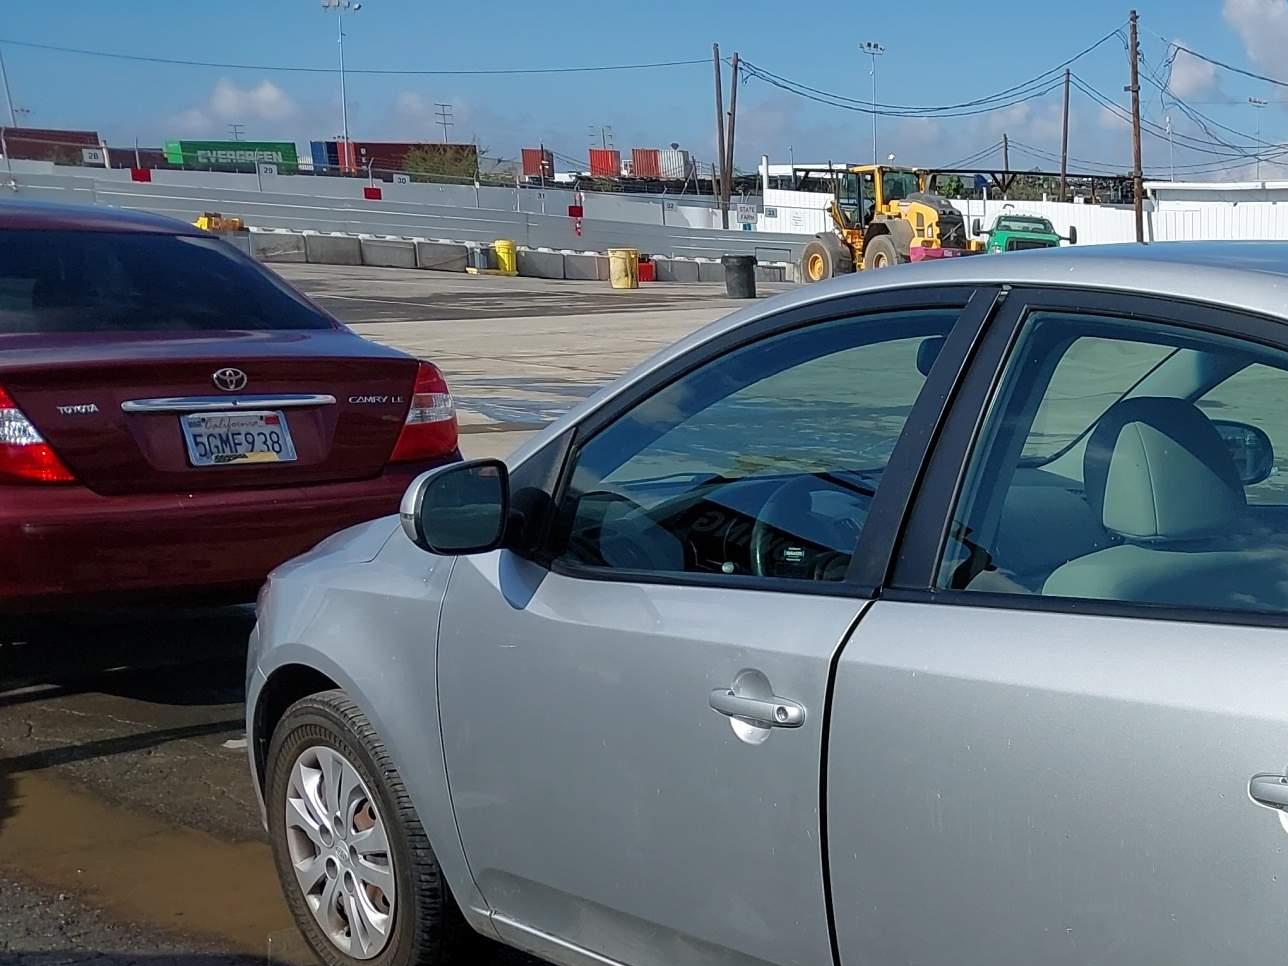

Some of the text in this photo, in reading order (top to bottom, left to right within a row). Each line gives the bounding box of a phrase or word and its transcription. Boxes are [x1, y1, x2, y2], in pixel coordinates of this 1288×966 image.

[197, 149, 283, 163] EVERGREEN
[348, 395, 388, 404] CAMRY
[56, 403, 99, 415] TOYOTA
[204, 416, 259, 433] California
[192, 430, 283, 458] 5GMF938
